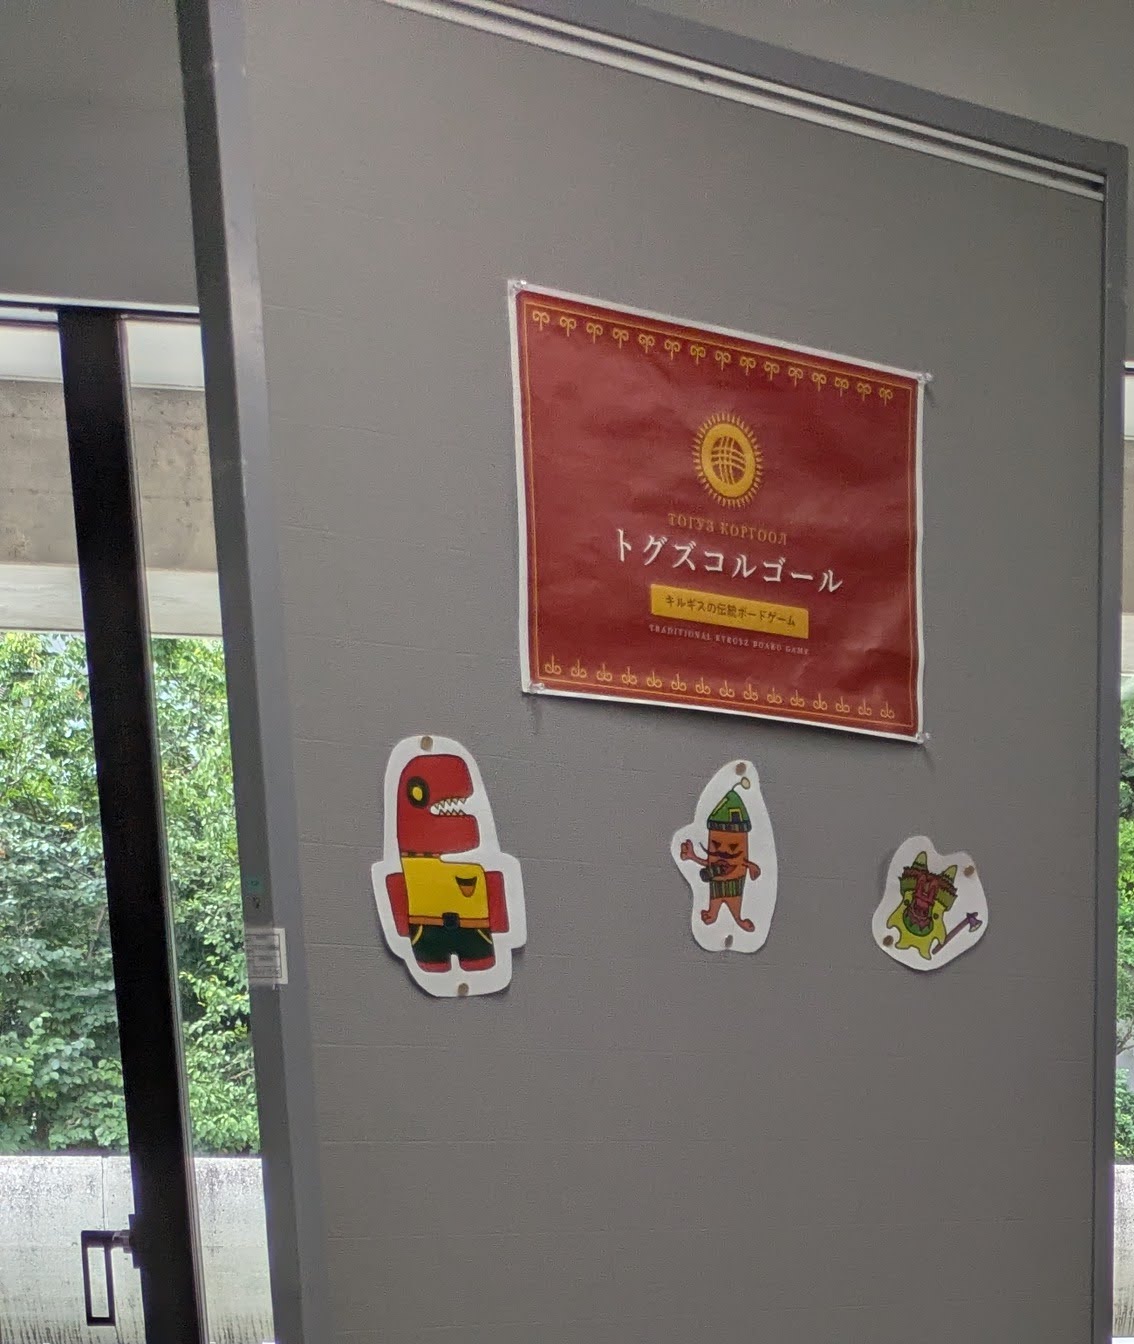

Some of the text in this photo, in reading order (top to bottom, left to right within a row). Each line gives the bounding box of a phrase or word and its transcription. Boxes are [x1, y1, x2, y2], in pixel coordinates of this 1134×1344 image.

[616, 527, 844, 593] トグズコルゴール
[665, 593, 796, 627] キルギスの伝統ボードゲーム
[649, 623, 712, 642] TRADITIONAL
